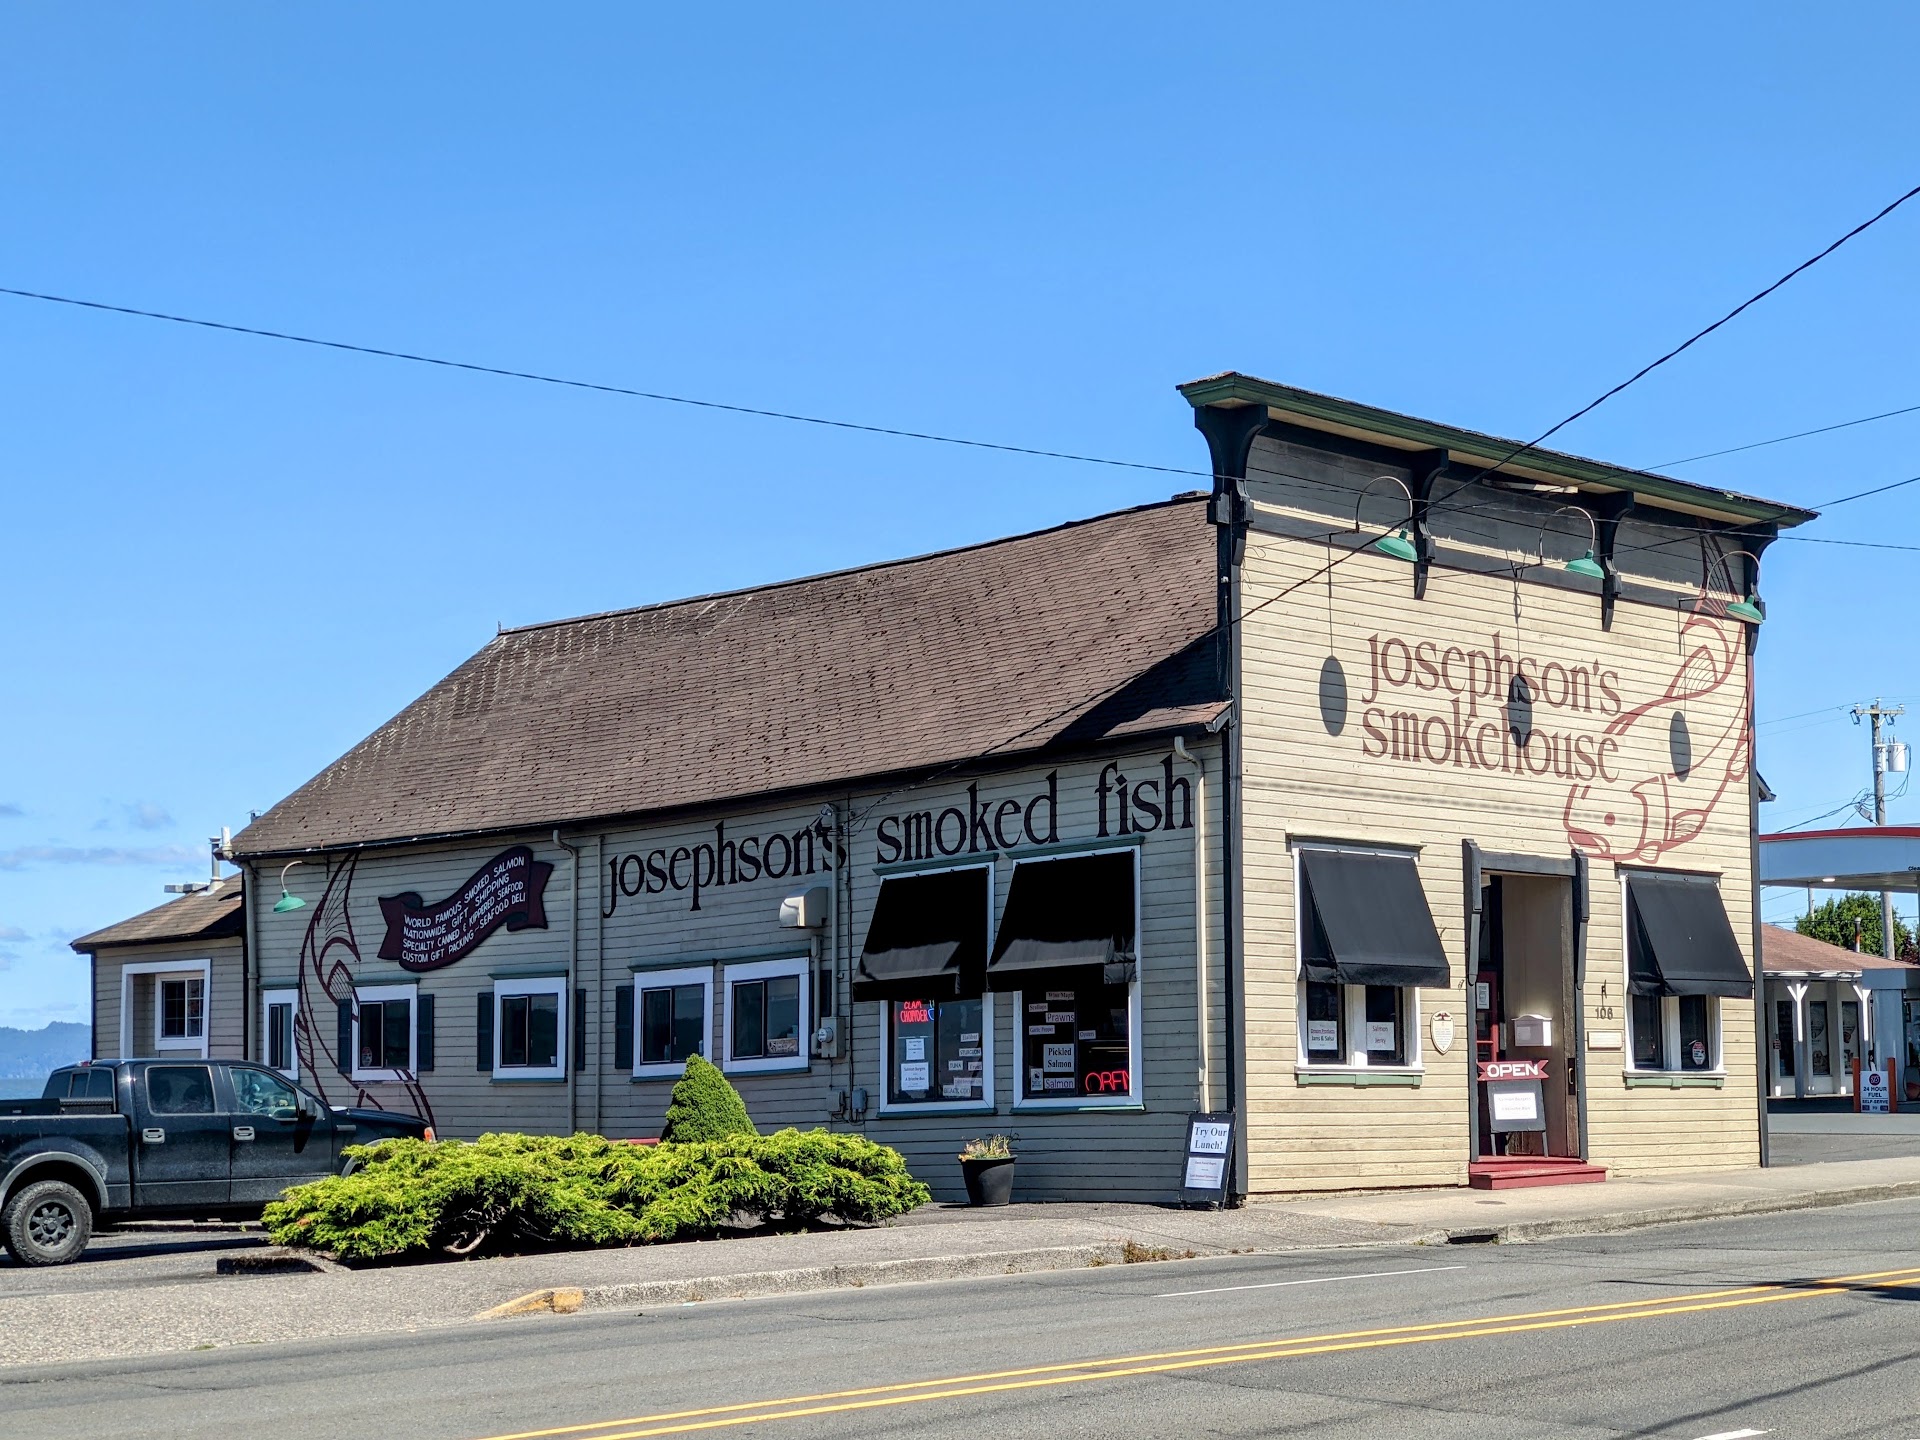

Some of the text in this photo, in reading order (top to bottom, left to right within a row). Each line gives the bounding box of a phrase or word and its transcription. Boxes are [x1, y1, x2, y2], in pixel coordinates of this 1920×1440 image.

[876, 769, 1061, 865] smoked
[1095, 757, 1195, 838] fish
[404, 856, 525, 928] WORLD FAMOUS SMOKED SALMON
[403, 873, 510, 940] NATIONWIDE GIFT SHIPPING
[402, 938, 435, 952] SPECIALTY
[437, 928, 460, 947] CANNED
[468, 895, 495, 927] KIPPERED
[497, 881, 524, 901] SEAFOOD
[402, 950, 429, 963] CUSTOM
[430, 949, 444, 962] GIFT
[448, 929, 474, 955] PACKING
[479, 900, 510, 929] SEAFOOD
[511, 892, 526, 905] DELI
[904, 1000, 922, 1010] CLAM
[900, 1009, 929, 1023] CHOWDER
[1047, 1013, 1074, 1022] Prawns
[1048, 1047, 1072, 1056] Pickled
[1047, 1060, 1072, 1068] Salmon
[1485, 1063, 1539, 1078] OPEN
[1045, 1079, 1074, 1089] Salmon
[1194, 1126, 1228, 1139] Try Our
[1194, 1140, 1223, 1150] Lunch!
